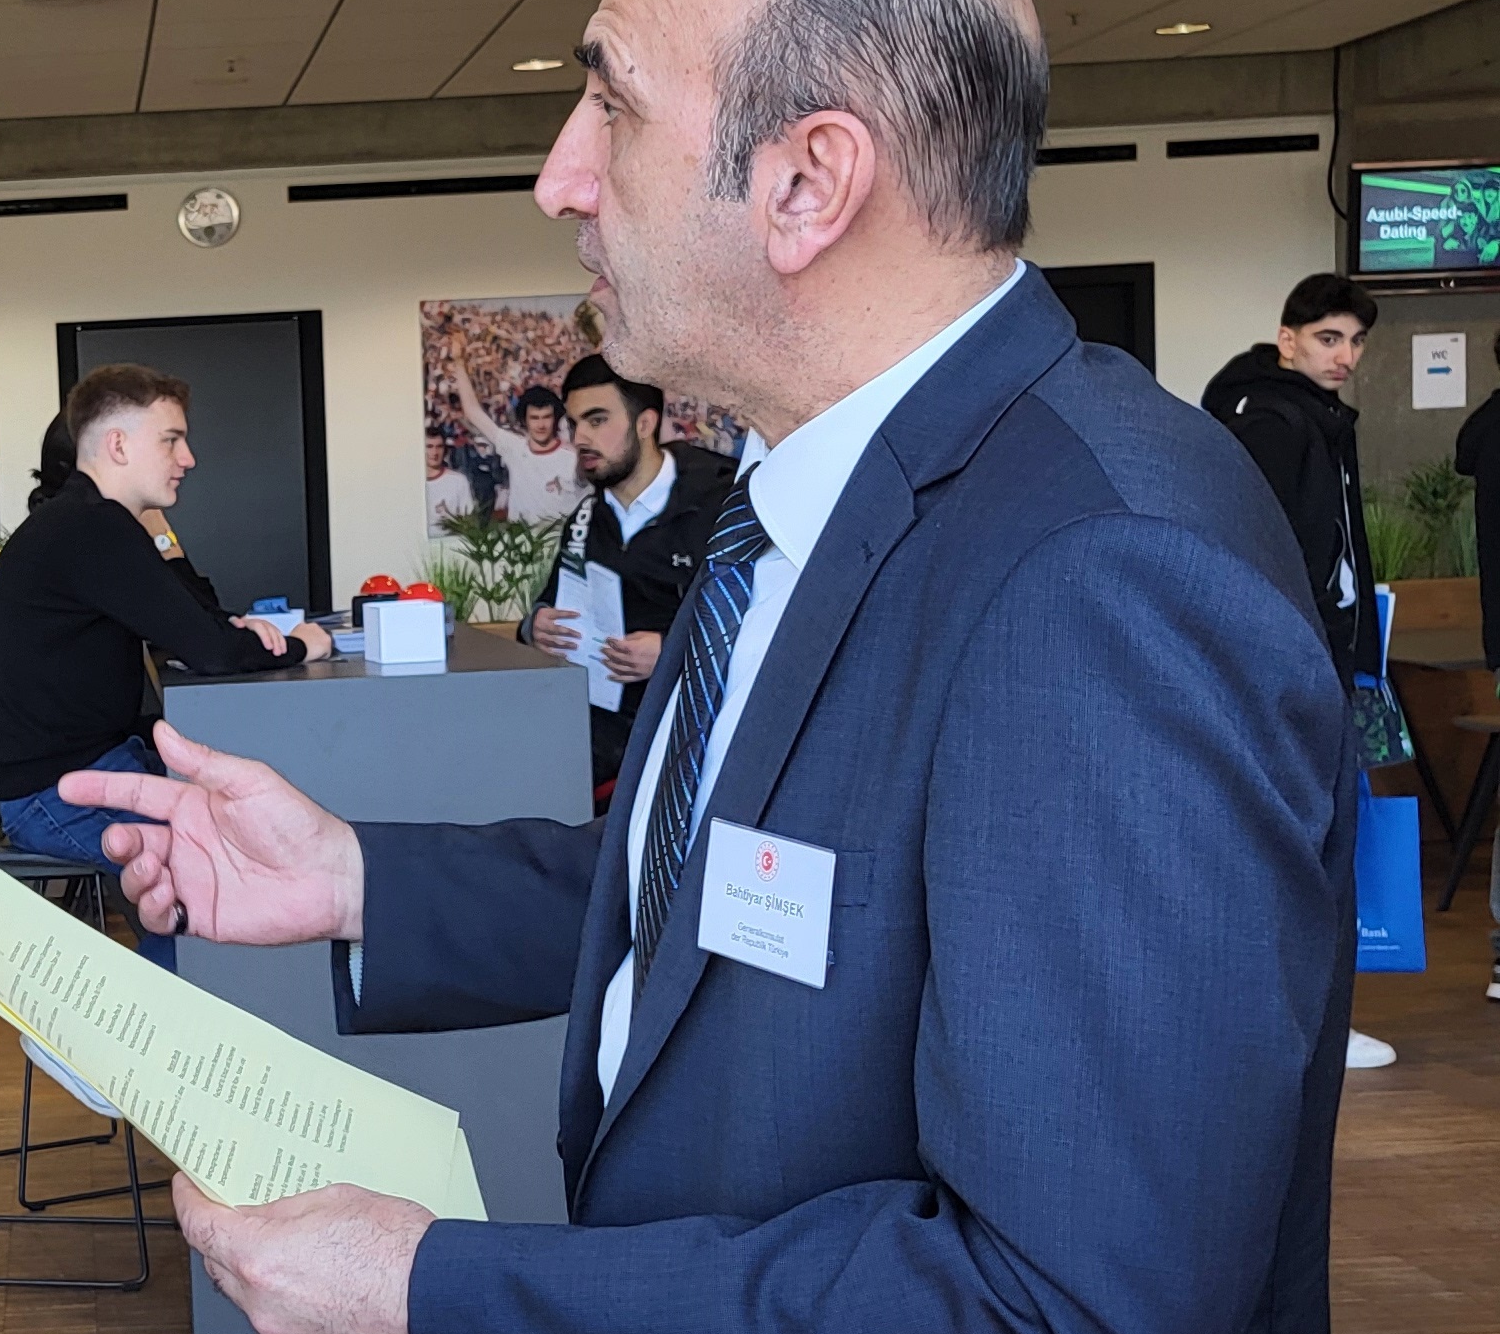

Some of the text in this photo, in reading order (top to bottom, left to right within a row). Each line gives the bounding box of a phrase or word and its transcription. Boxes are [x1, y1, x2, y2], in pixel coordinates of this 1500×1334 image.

[1366, 205, 1463, 223] Azubi-Speed-
[1379, 224, 1428, 241] Dating
[764, 893, 805, 918] ŞİMŞEK
